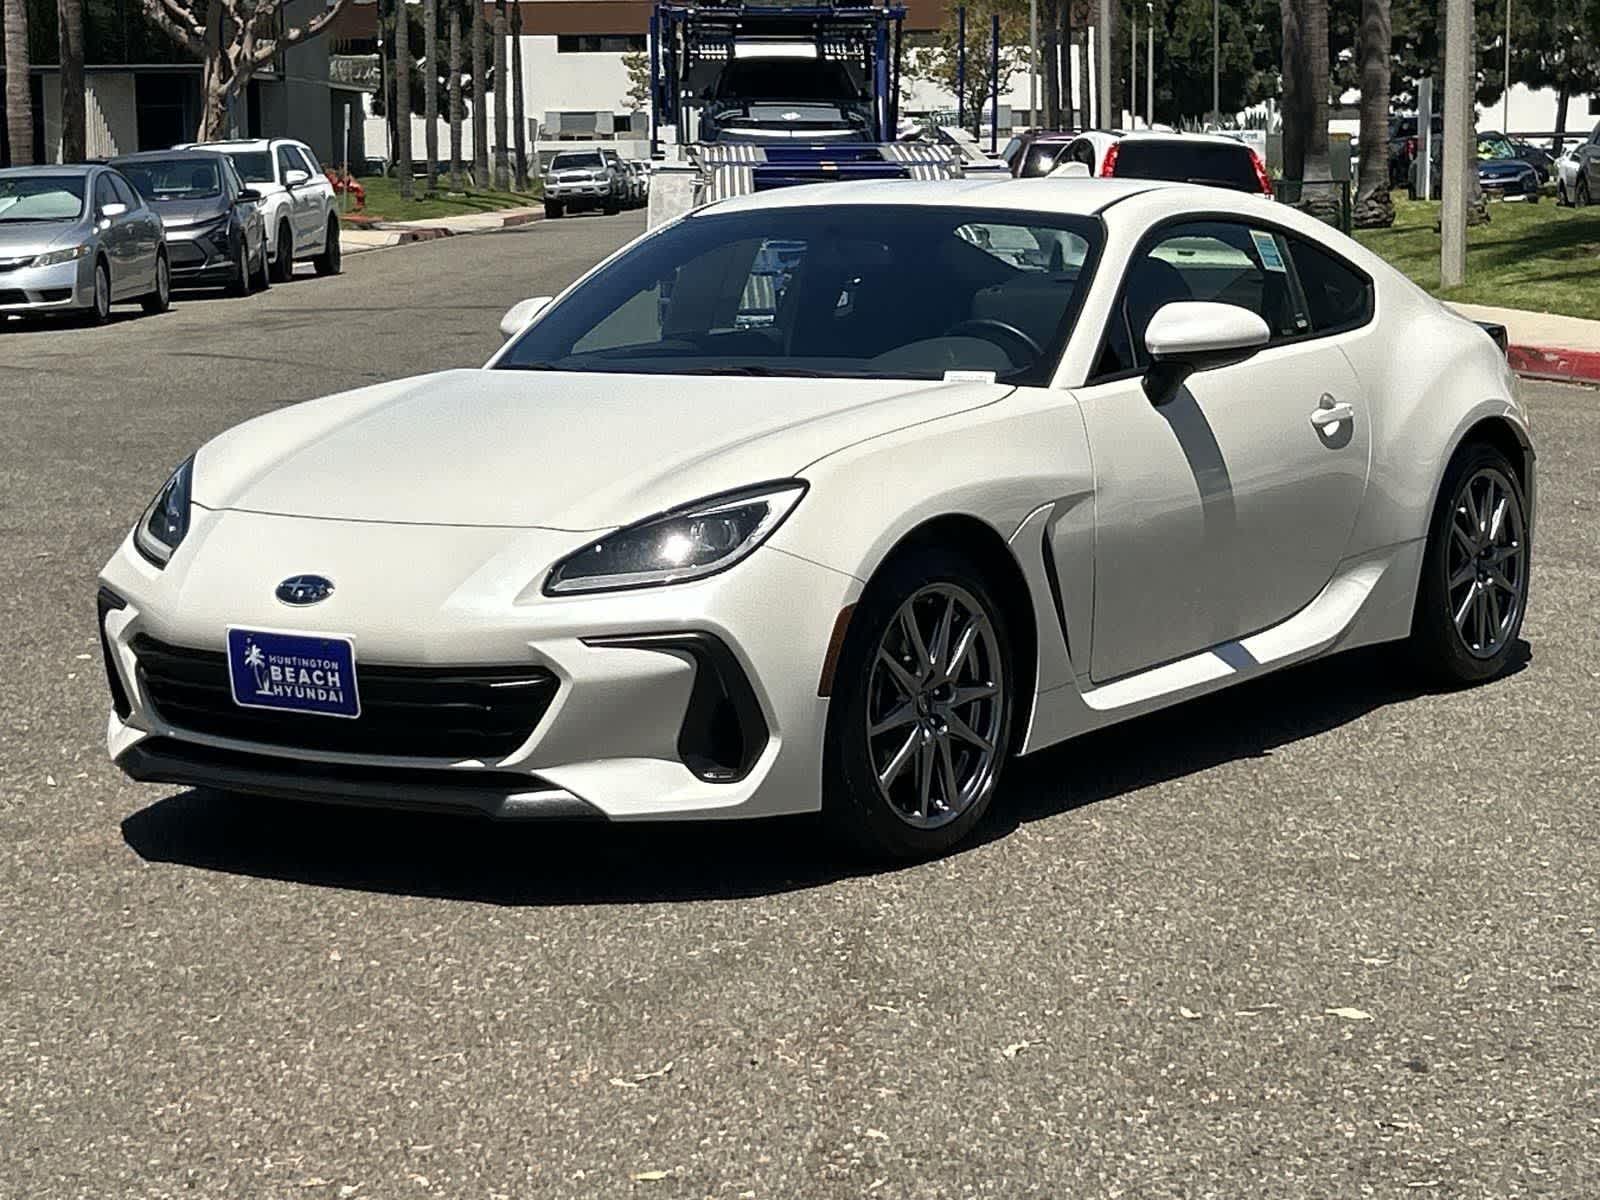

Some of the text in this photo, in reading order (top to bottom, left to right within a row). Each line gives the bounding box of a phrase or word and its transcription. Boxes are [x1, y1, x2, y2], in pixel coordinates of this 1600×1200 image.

[268, 655, 339, 670] HUNTINGTON
[270, 666, 341, 687] BEACH
[273, 685, 344, 704] HYUNDAI
